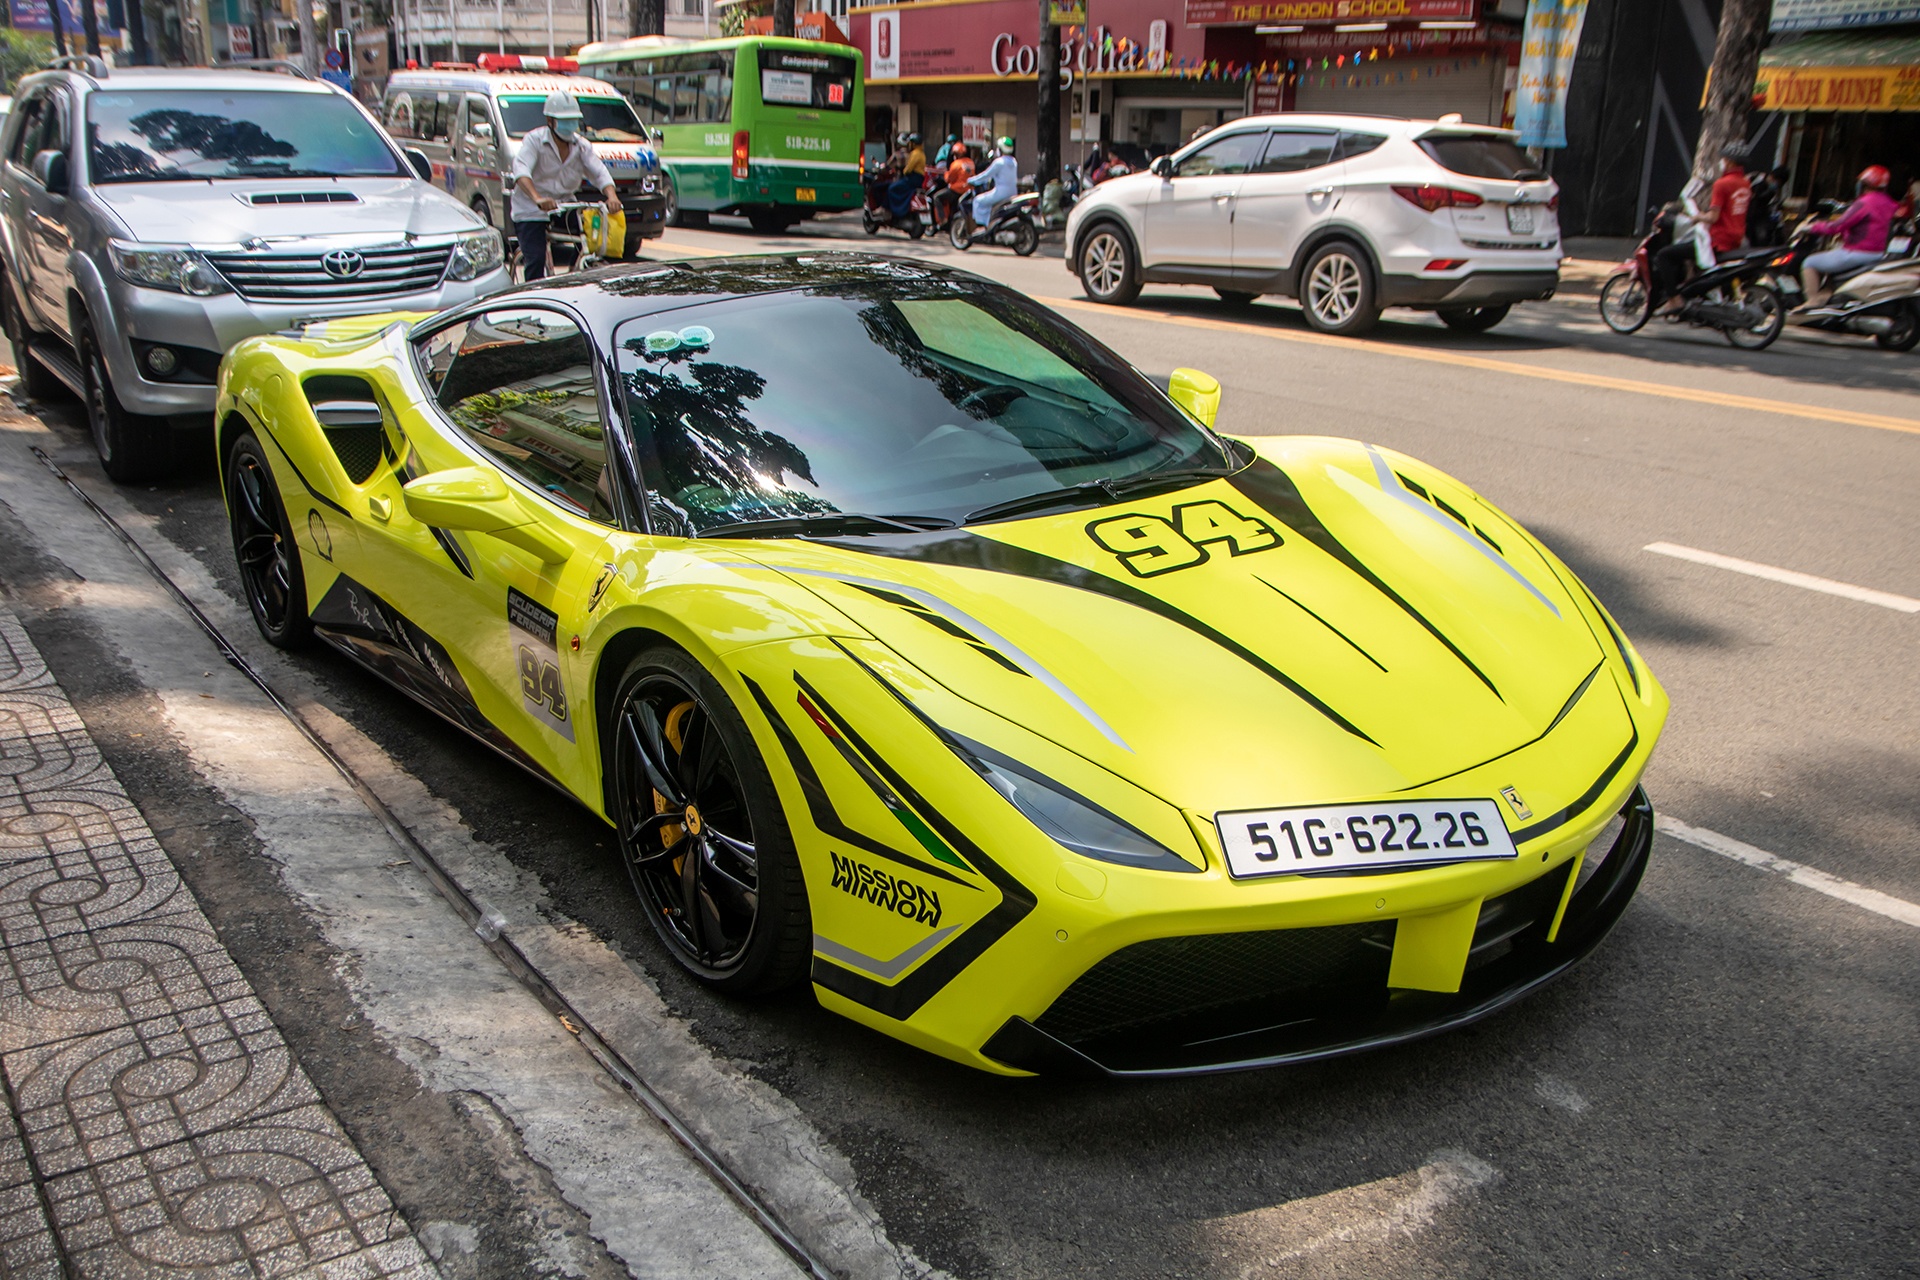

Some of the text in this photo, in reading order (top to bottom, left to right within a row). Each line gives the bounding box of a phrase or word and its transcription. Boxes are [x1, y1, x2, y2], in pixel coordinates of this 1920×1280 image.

[1232, 5, 1262, 20] THE
[1266, 2, 1334, 19] LONDON
[1337, 0, 1411, 17] SCHOOL
[782, 55, 829, 69] SaigonBus
[990, 32, 1074, 91] Gog
[1825, 77, 1885, 105] MINH
[1085, 499, 1285, 579] 94
[508, 591, 557, 630] SCUDERIA
[510, 608, 551, 643] FERRARI
[518, 643, 567, 723] 94
[1246, 811, 1490, 862] 51G-622.26
[829, 850, 942, 911] MISSION
[830, 874, 943, 929] WINNOW
